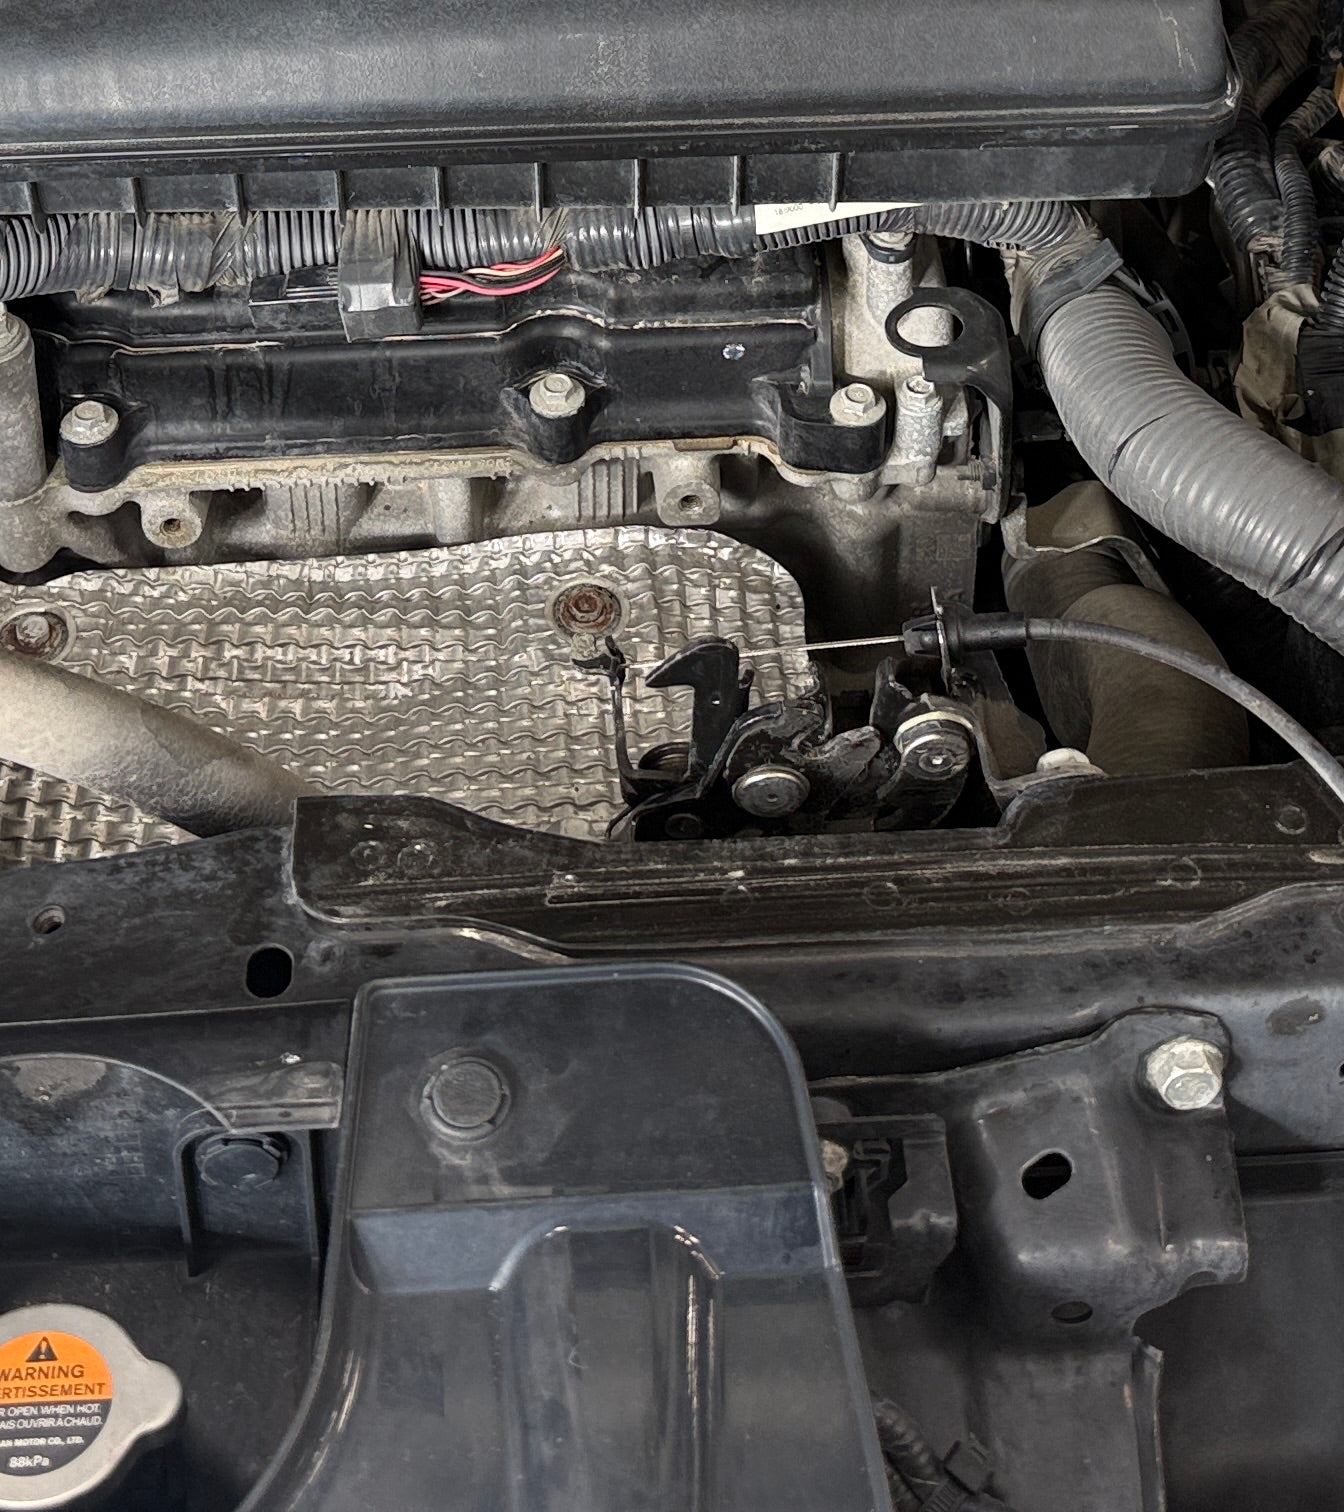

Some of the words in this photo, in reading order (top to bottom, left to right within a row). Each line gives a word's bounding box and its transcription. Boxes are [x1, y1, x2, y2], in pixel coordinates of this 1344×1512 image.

[7, 1405, 39, 1417] OPEN
[39, 1404, 75, 1416] WHEN
[16, 1417, 57, 1429] OUVRIR
[13, 1437, 47, 1447] MOTOR
[66, 1436, 85, 1445] LTD.
[9, 1455, 50, 1469] 88kPa
